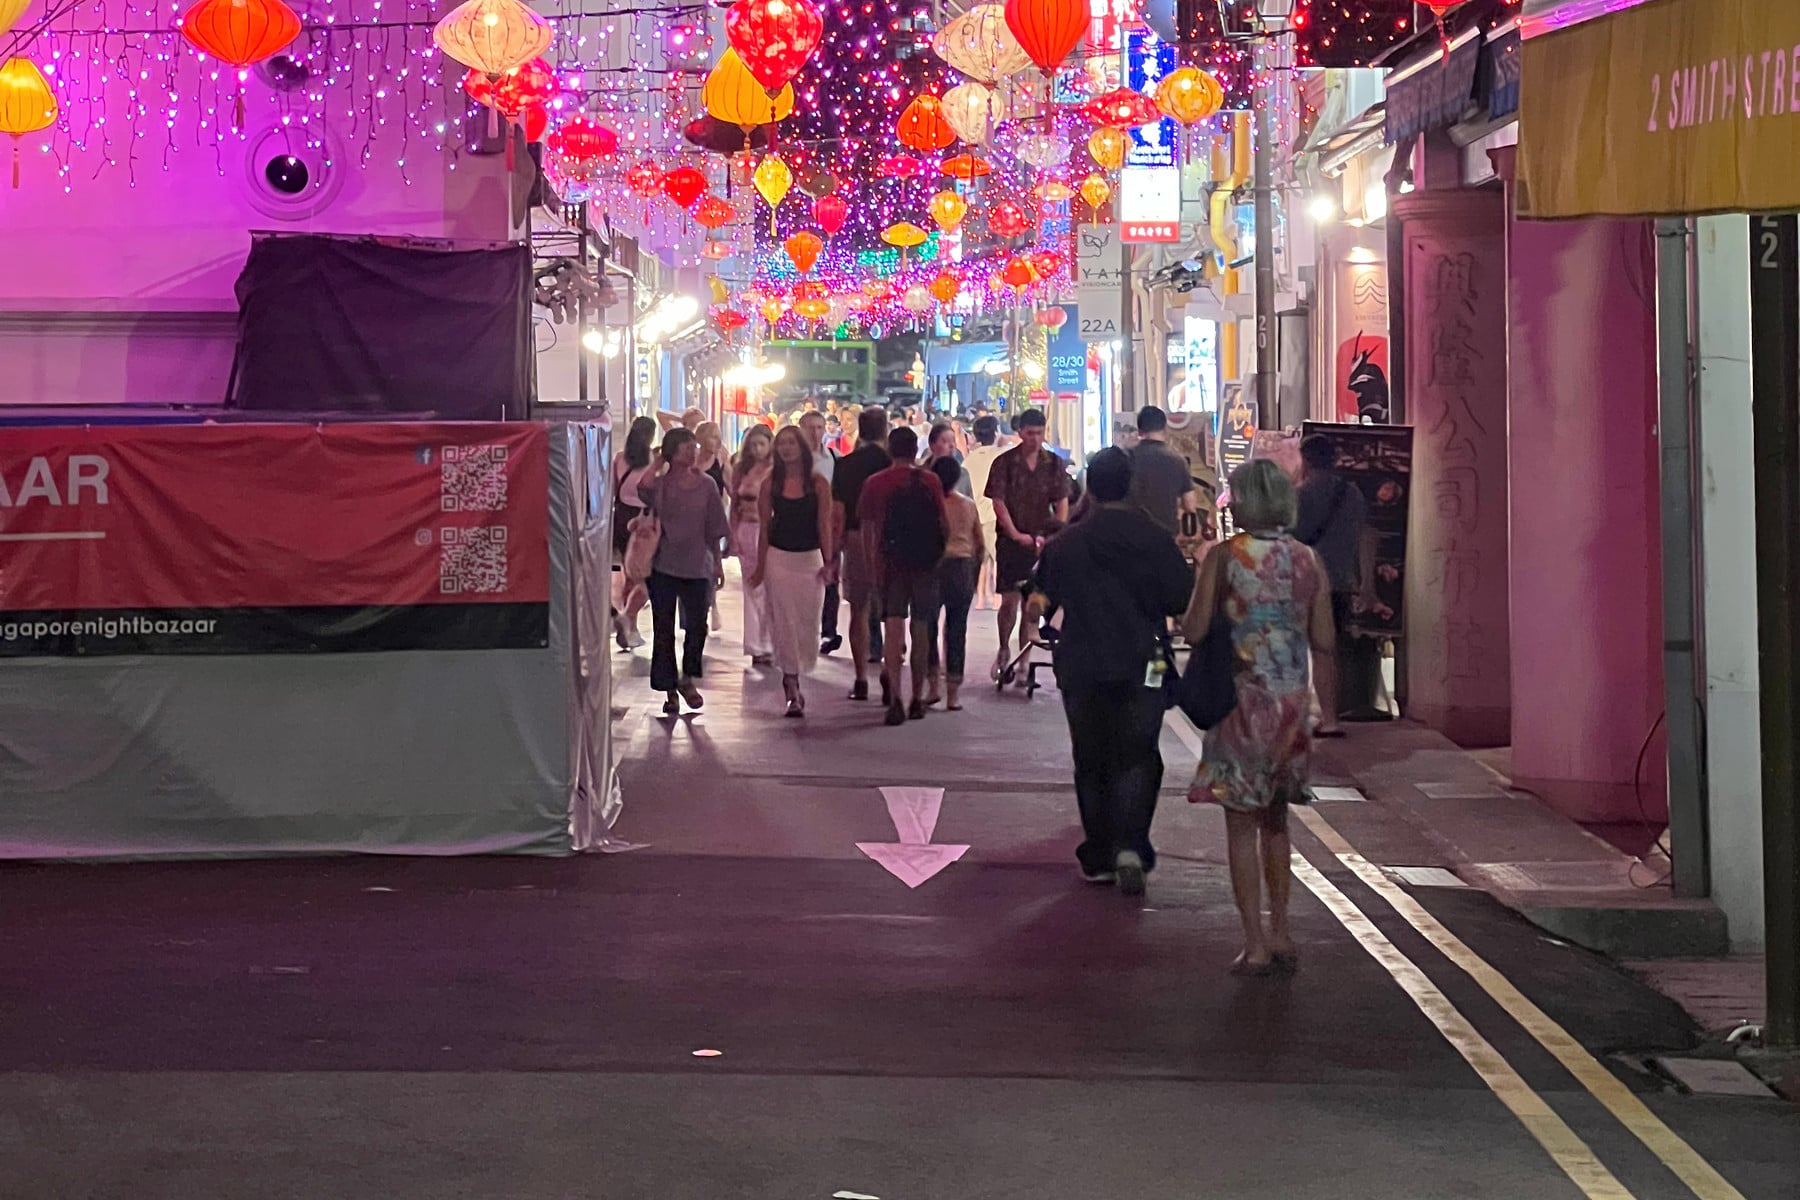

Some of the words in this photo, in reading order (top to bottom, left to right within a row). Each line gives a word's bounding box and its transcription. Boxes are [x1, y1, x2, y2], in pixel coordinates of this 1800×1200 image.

[1648, 73, 1661, 131] 2
[1668, 56, 1736, 130] SMITH
[1081, 319, 1117, 333] 22A
[1052, 355, 1085, 368] 28/30
[1058, 369, 1079, 377] Smith
[0, 454, 110, 508] AR
[0, 617, 217, 640] gaporenightbazaar
